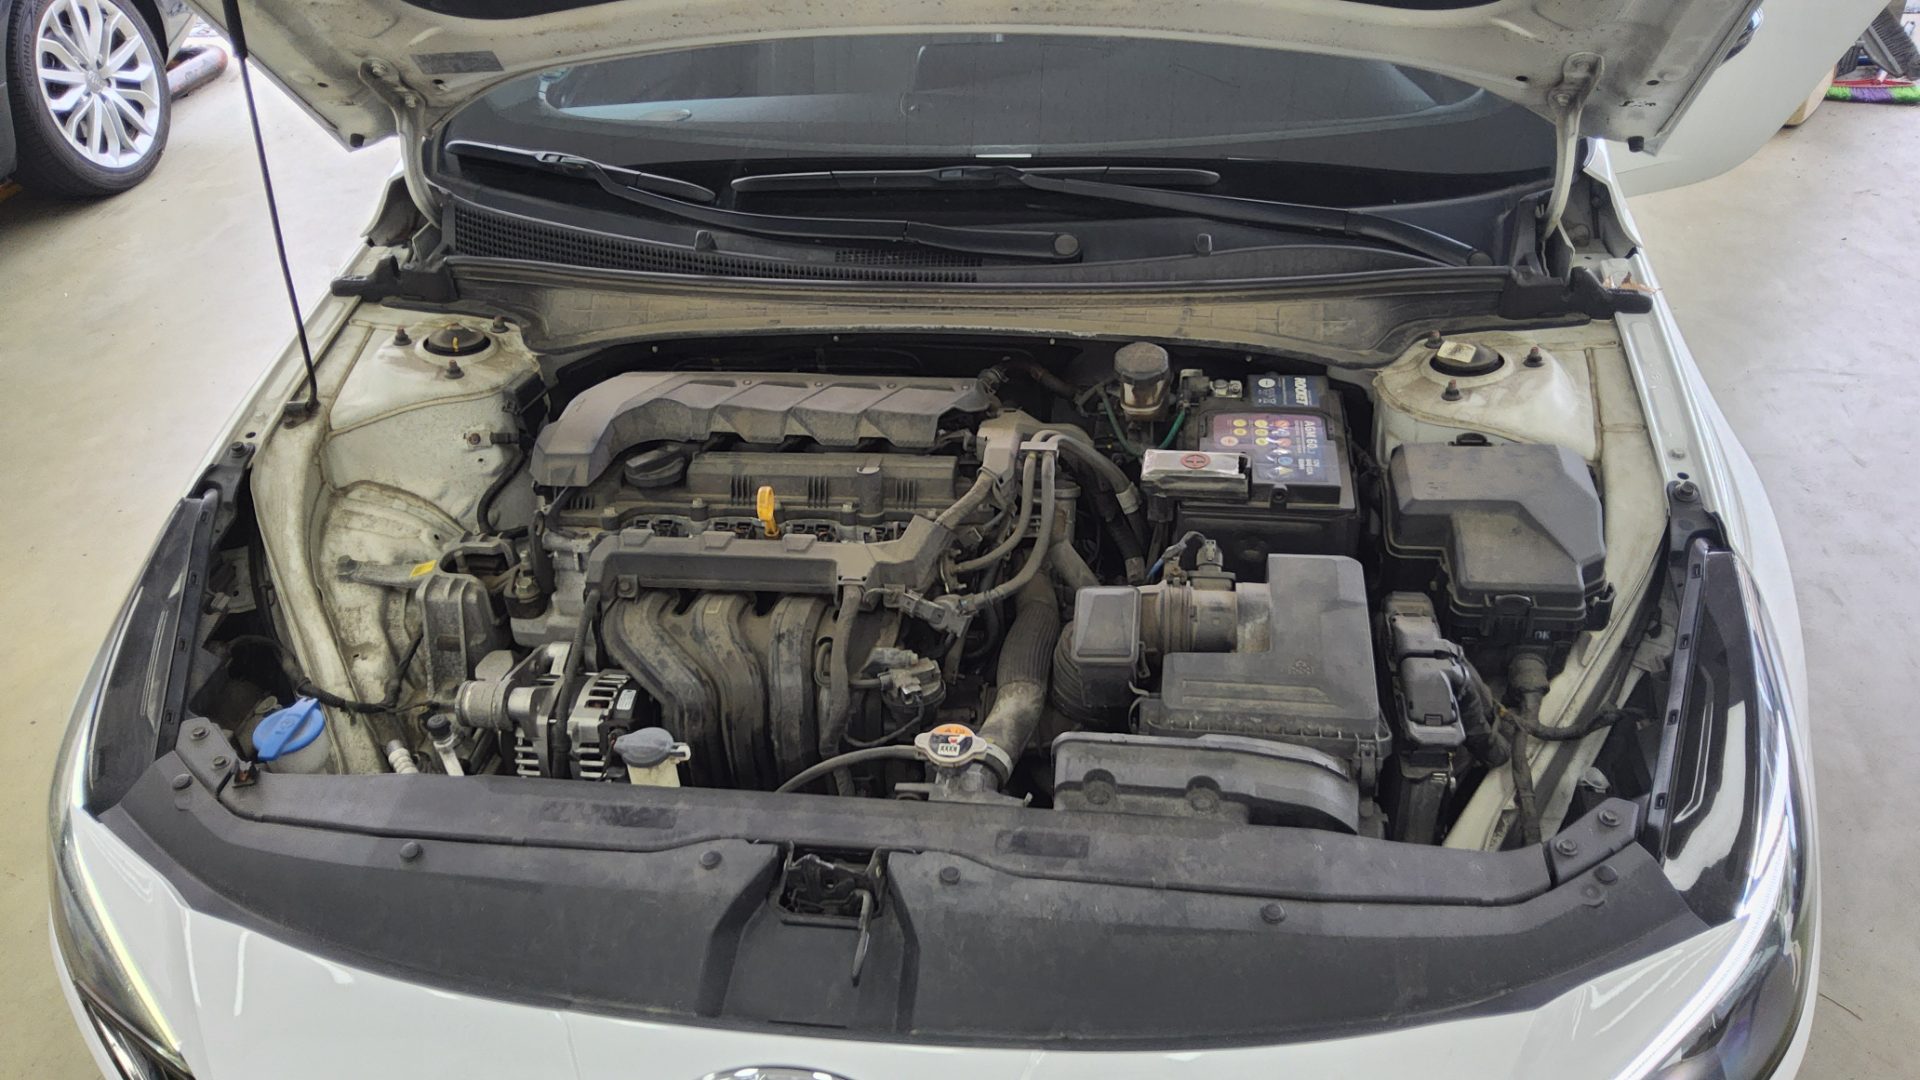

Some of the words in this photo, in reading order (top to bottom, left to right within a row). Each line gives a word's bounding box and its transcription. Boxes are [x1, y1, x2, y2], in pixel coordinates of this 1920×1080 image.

[23, 34, 34, 87] KUMHO
[1294, 377, 1308, 406] ROCKET
[1304, 421, 1317, 438] AGM
